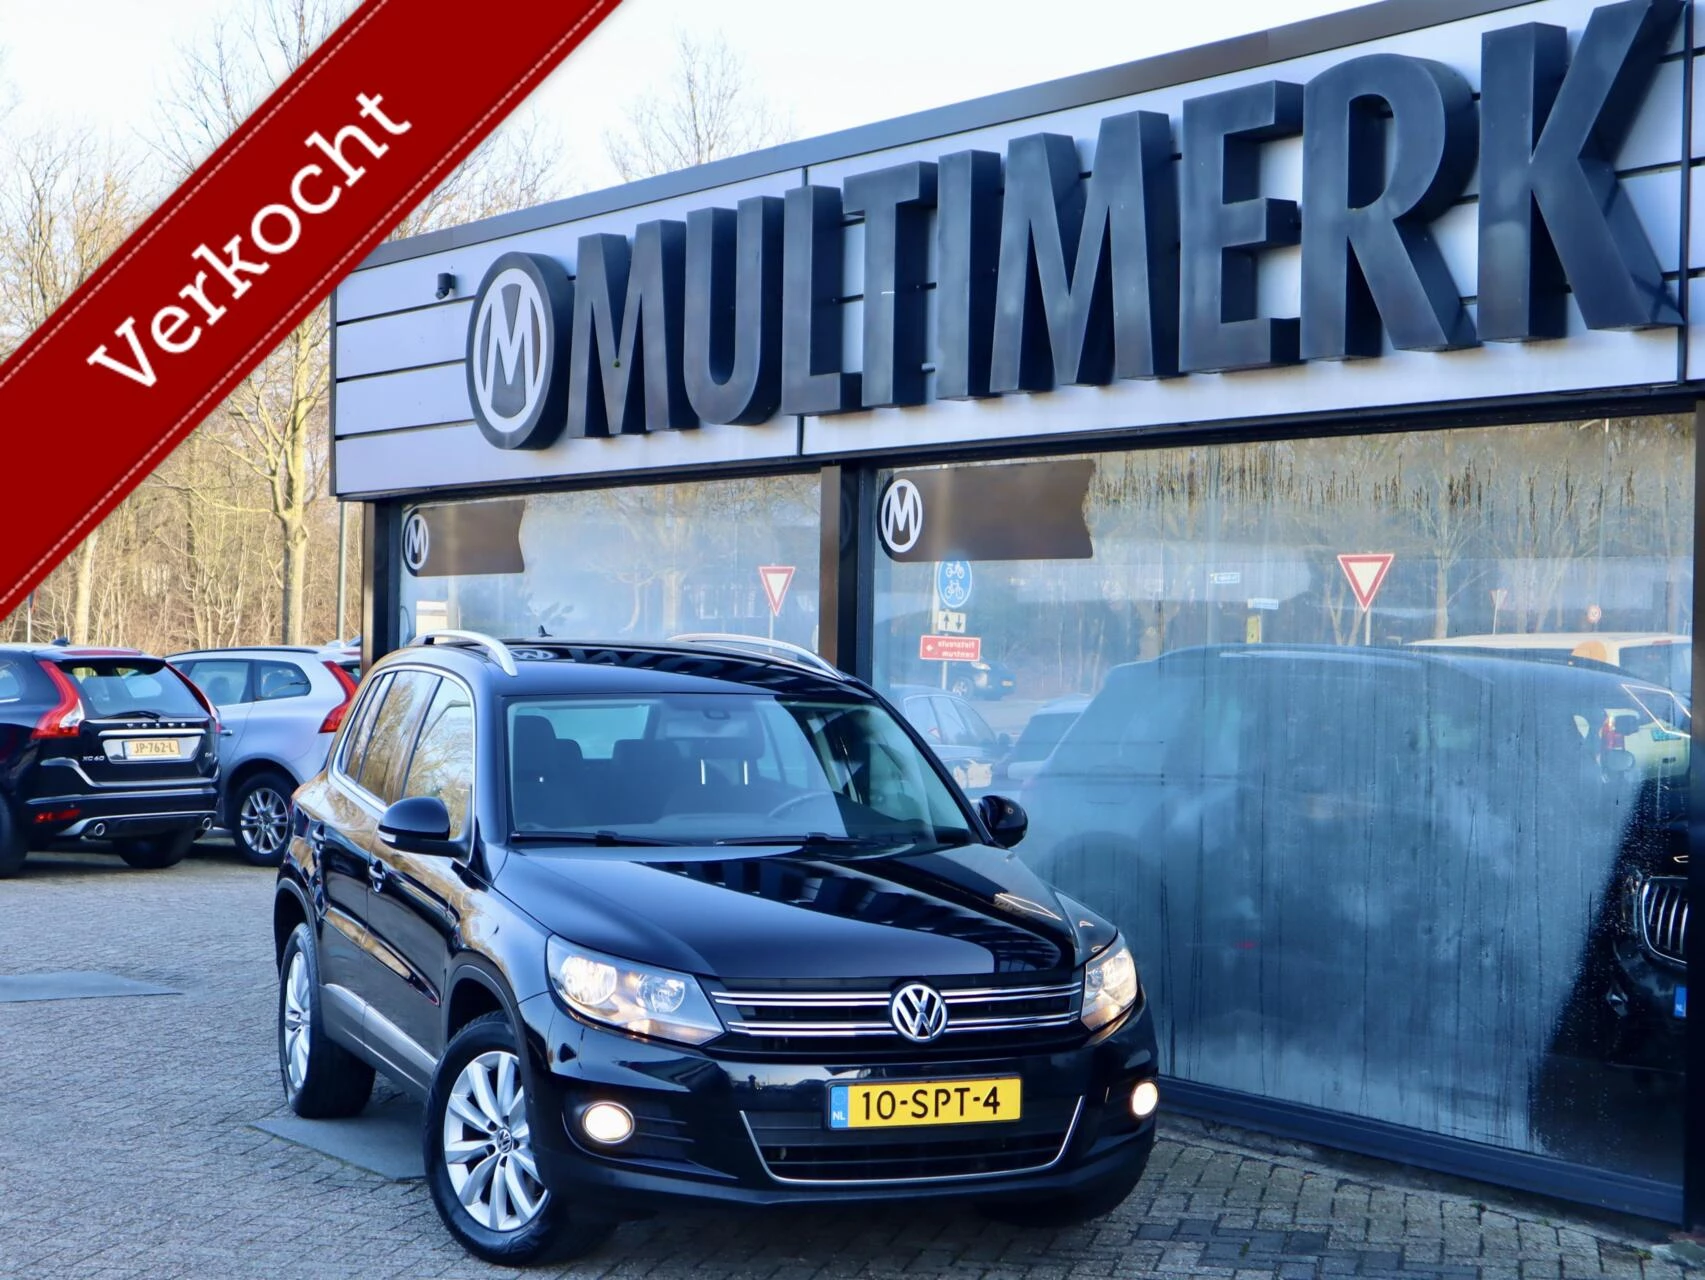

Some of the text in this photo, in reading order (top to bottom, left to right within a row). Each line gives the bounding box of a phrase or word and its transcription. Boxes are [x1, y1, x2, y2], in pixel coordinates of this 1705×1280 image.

[567, 0, 1682, 438] MULTIMERK
[134, 739, 175, 754] JP-762-L
[832, 1086, 1001, 1121] NL 10-SPT-4
